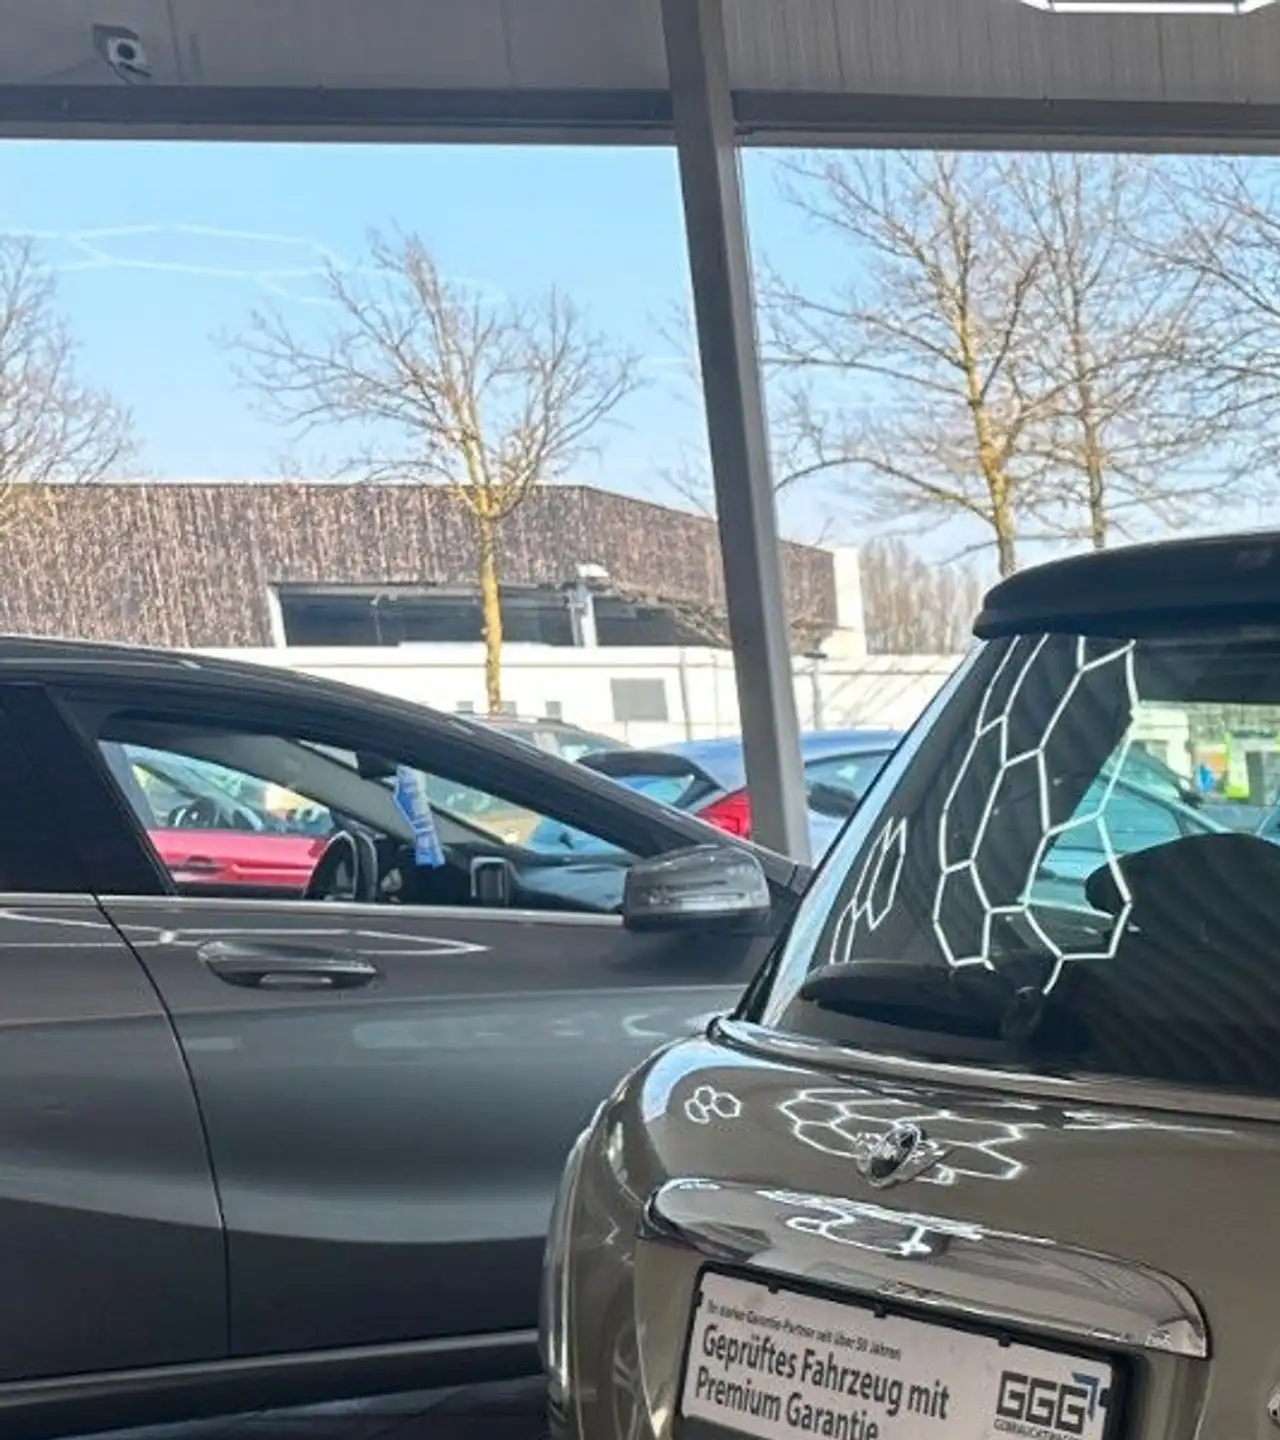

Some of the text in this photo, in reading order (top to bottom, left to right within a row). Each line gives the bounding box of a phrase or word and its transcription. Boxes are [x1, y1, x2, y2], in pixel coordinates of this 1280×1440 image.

[695, 1366, 780, 1422] Premium
[702, 1323, 950, 1420] Geprüftes Fahrzeug mit
[996, 1370, 1089, 1434] GGG
